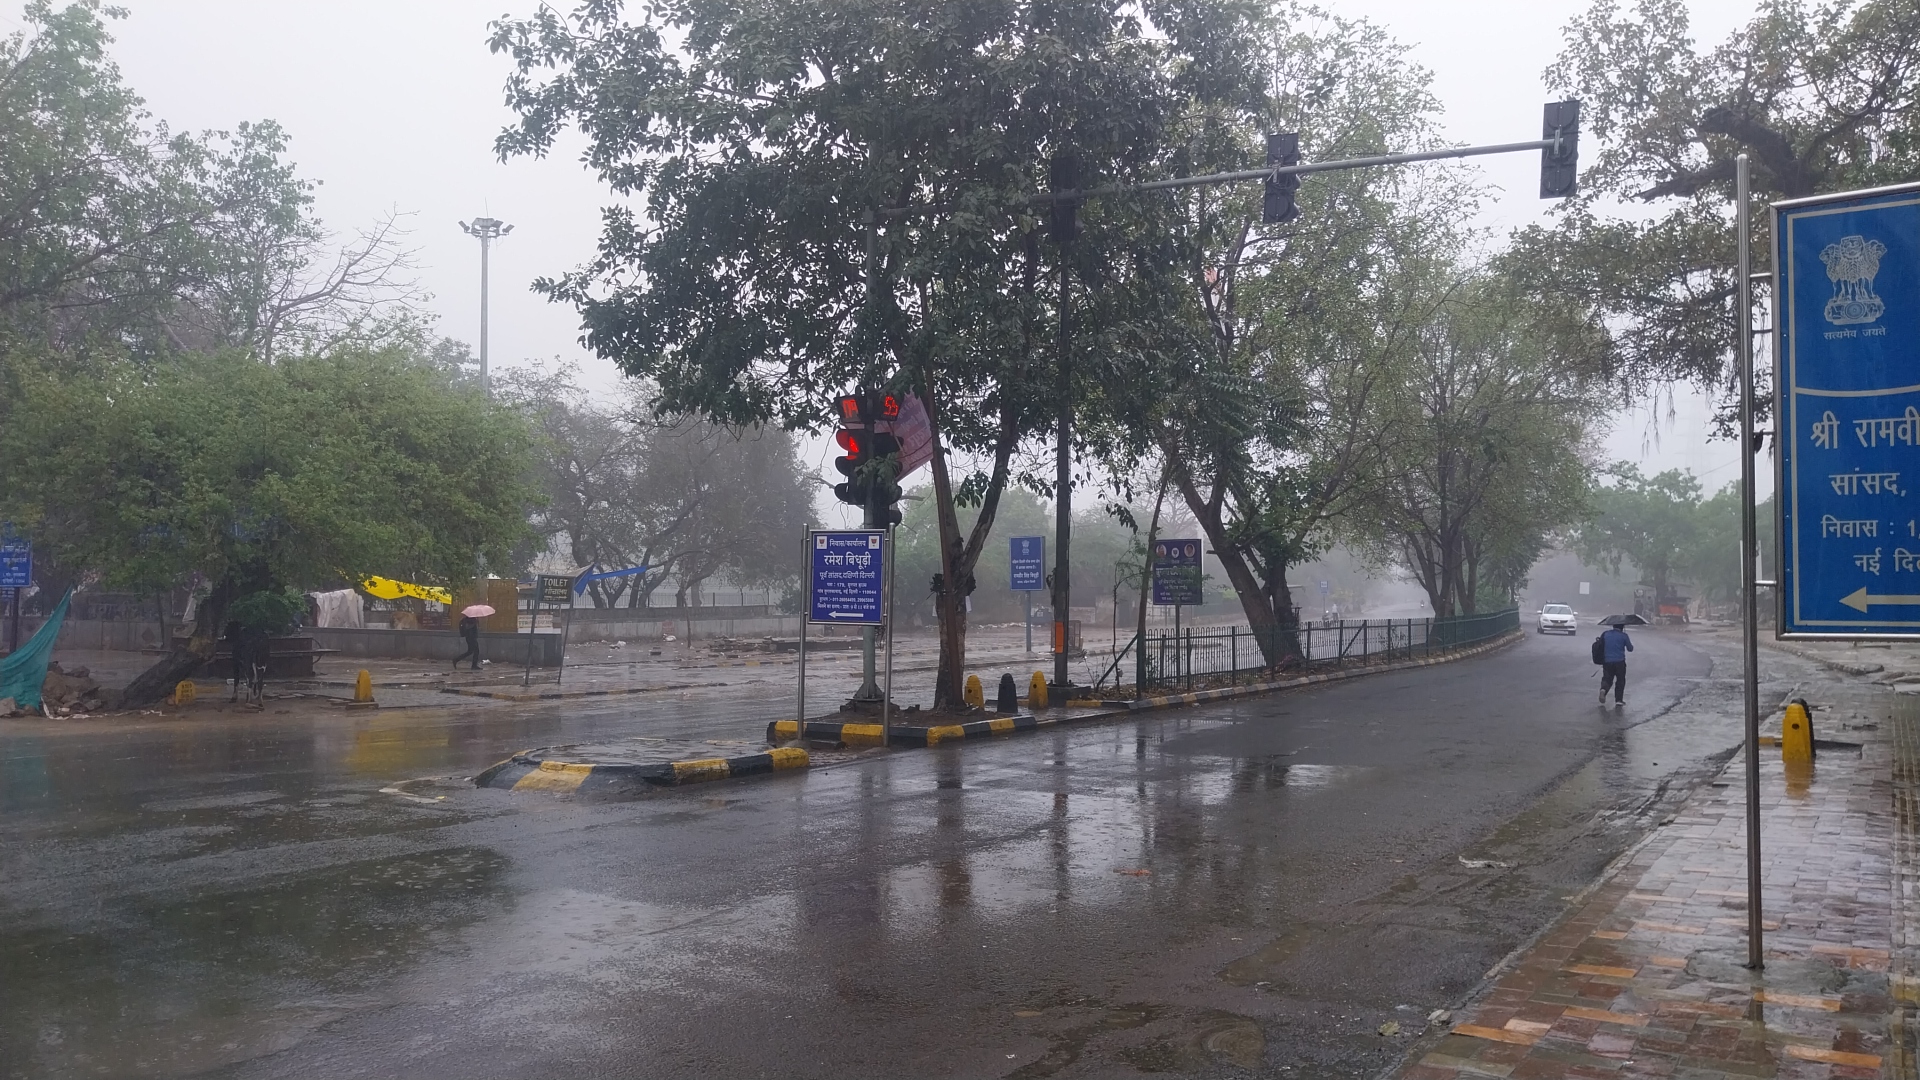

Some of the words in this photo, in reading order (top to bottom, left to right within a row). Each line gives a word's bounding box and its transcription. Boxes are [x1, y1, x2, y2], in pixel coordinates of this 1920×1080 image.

[1823, 328, 1857, 340] सत्यमेव
[1862, 325, 1887, 337] जयते
[1810, 410, 1840, 449] श्री
[1828, 467, 1907, 497] सांसद,
[1820, 514, 1879, 538] निवास
[824, 551, 843, 565] रमेश
[846, 552, 871, 569] बिधूड़ी
[1853, 547, 1882, 576] नई
[544, 578, 568, 586] TOILET
